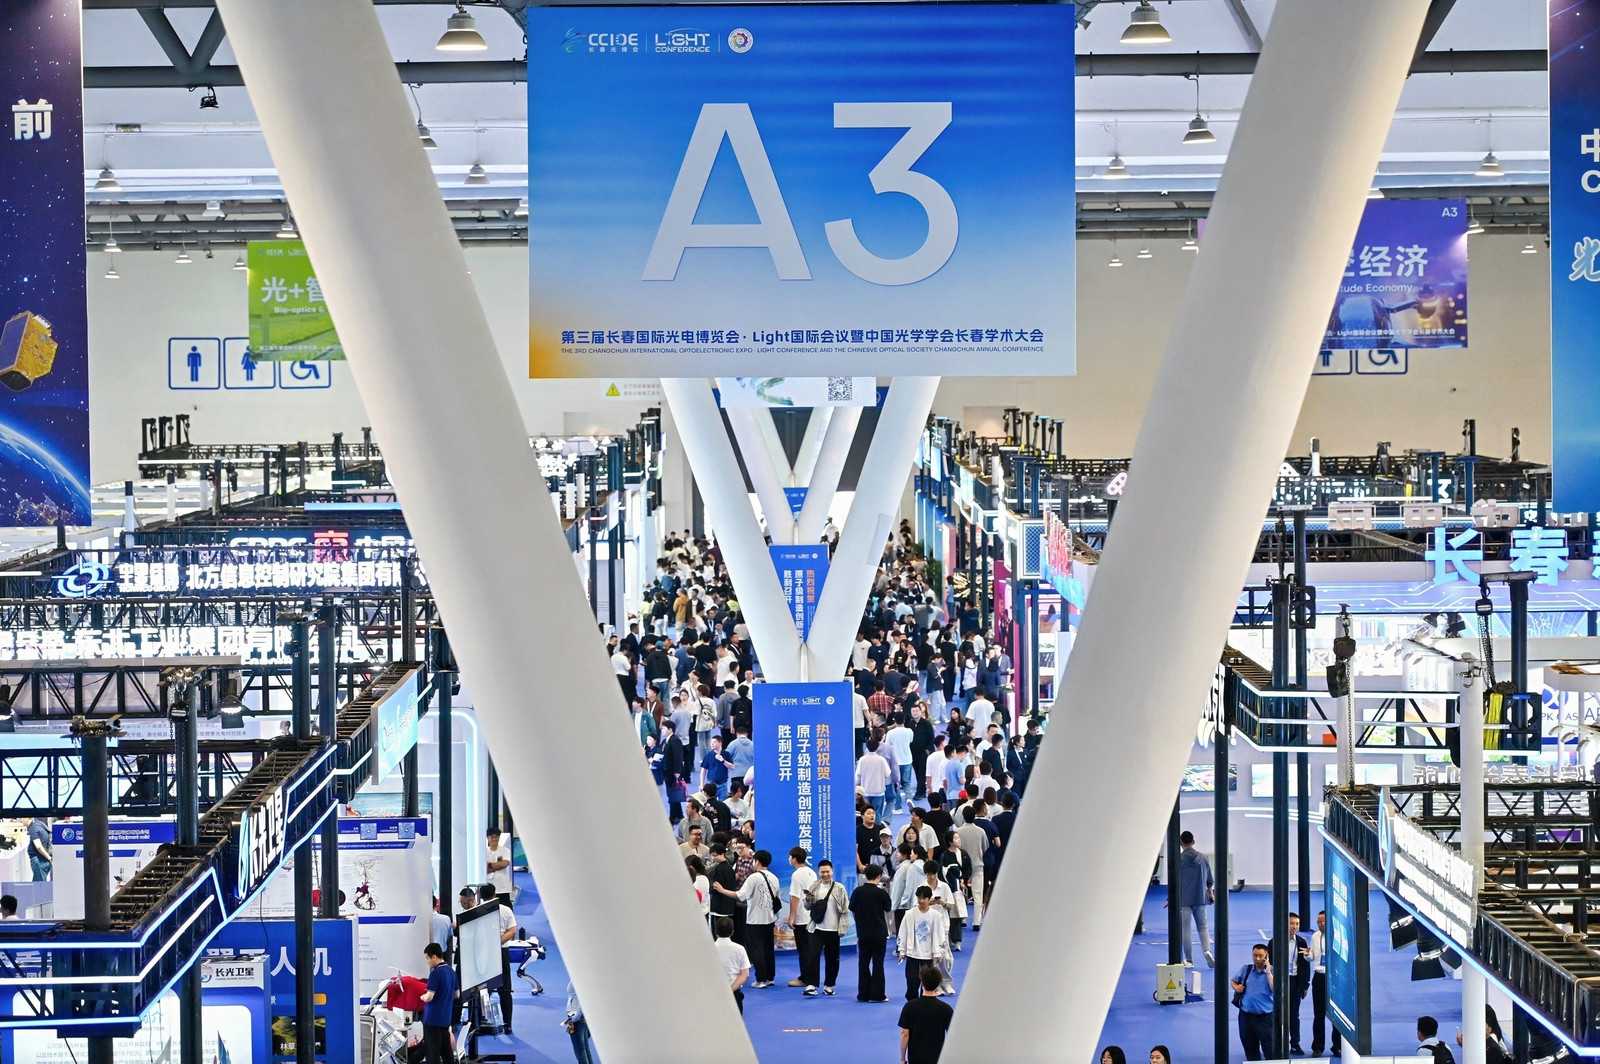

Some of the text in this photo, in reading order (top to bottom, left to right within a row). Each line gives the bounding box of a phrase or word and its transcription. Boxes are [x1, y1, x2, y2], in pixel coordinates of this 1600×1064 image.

[588, 33, 639, 46] CCIDE
[655, 31, 711, 46] LIGHT
[12, 98, 53, 140] 前
[642, 102, 960, 286] A3
[1441, 207, 1459, 218] A3
[1366, 283, 1413, 295] Economy
[274, 305, 317, 315] Bio-optics
[1424, 526, 1600, 588] 长春
[778, 724, 793, 782] 胜利召开
[816, 724, 831, 781] 热烈祝贺
[215, 967, 255, 977] 长光卫星
